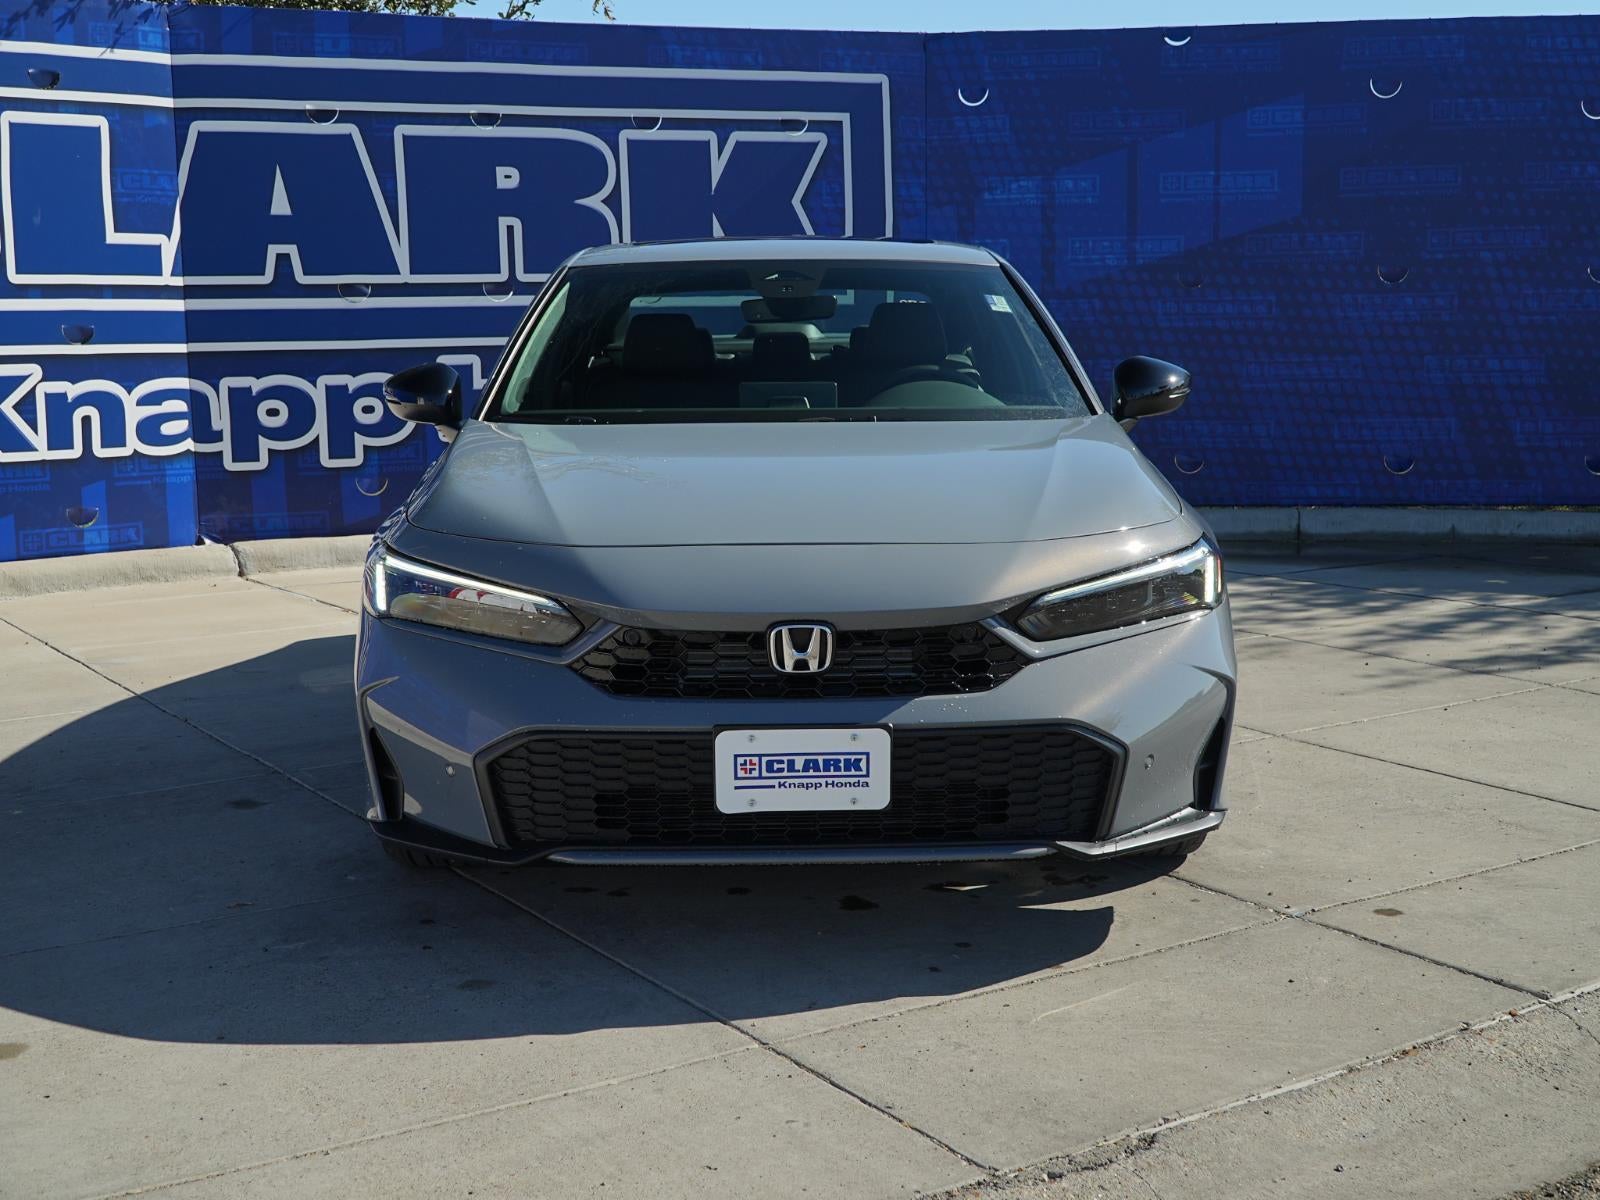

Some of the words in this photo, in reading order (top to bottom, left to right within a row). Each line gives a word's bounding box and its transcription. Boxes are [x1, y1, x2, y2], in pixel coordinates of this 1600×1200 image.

[0, 111, 829, 285] LARK
[765, 757, 863, 774] CLARK
[777, 780, 823, 791] Knapp
[825, 779, 870, 789] Honda
